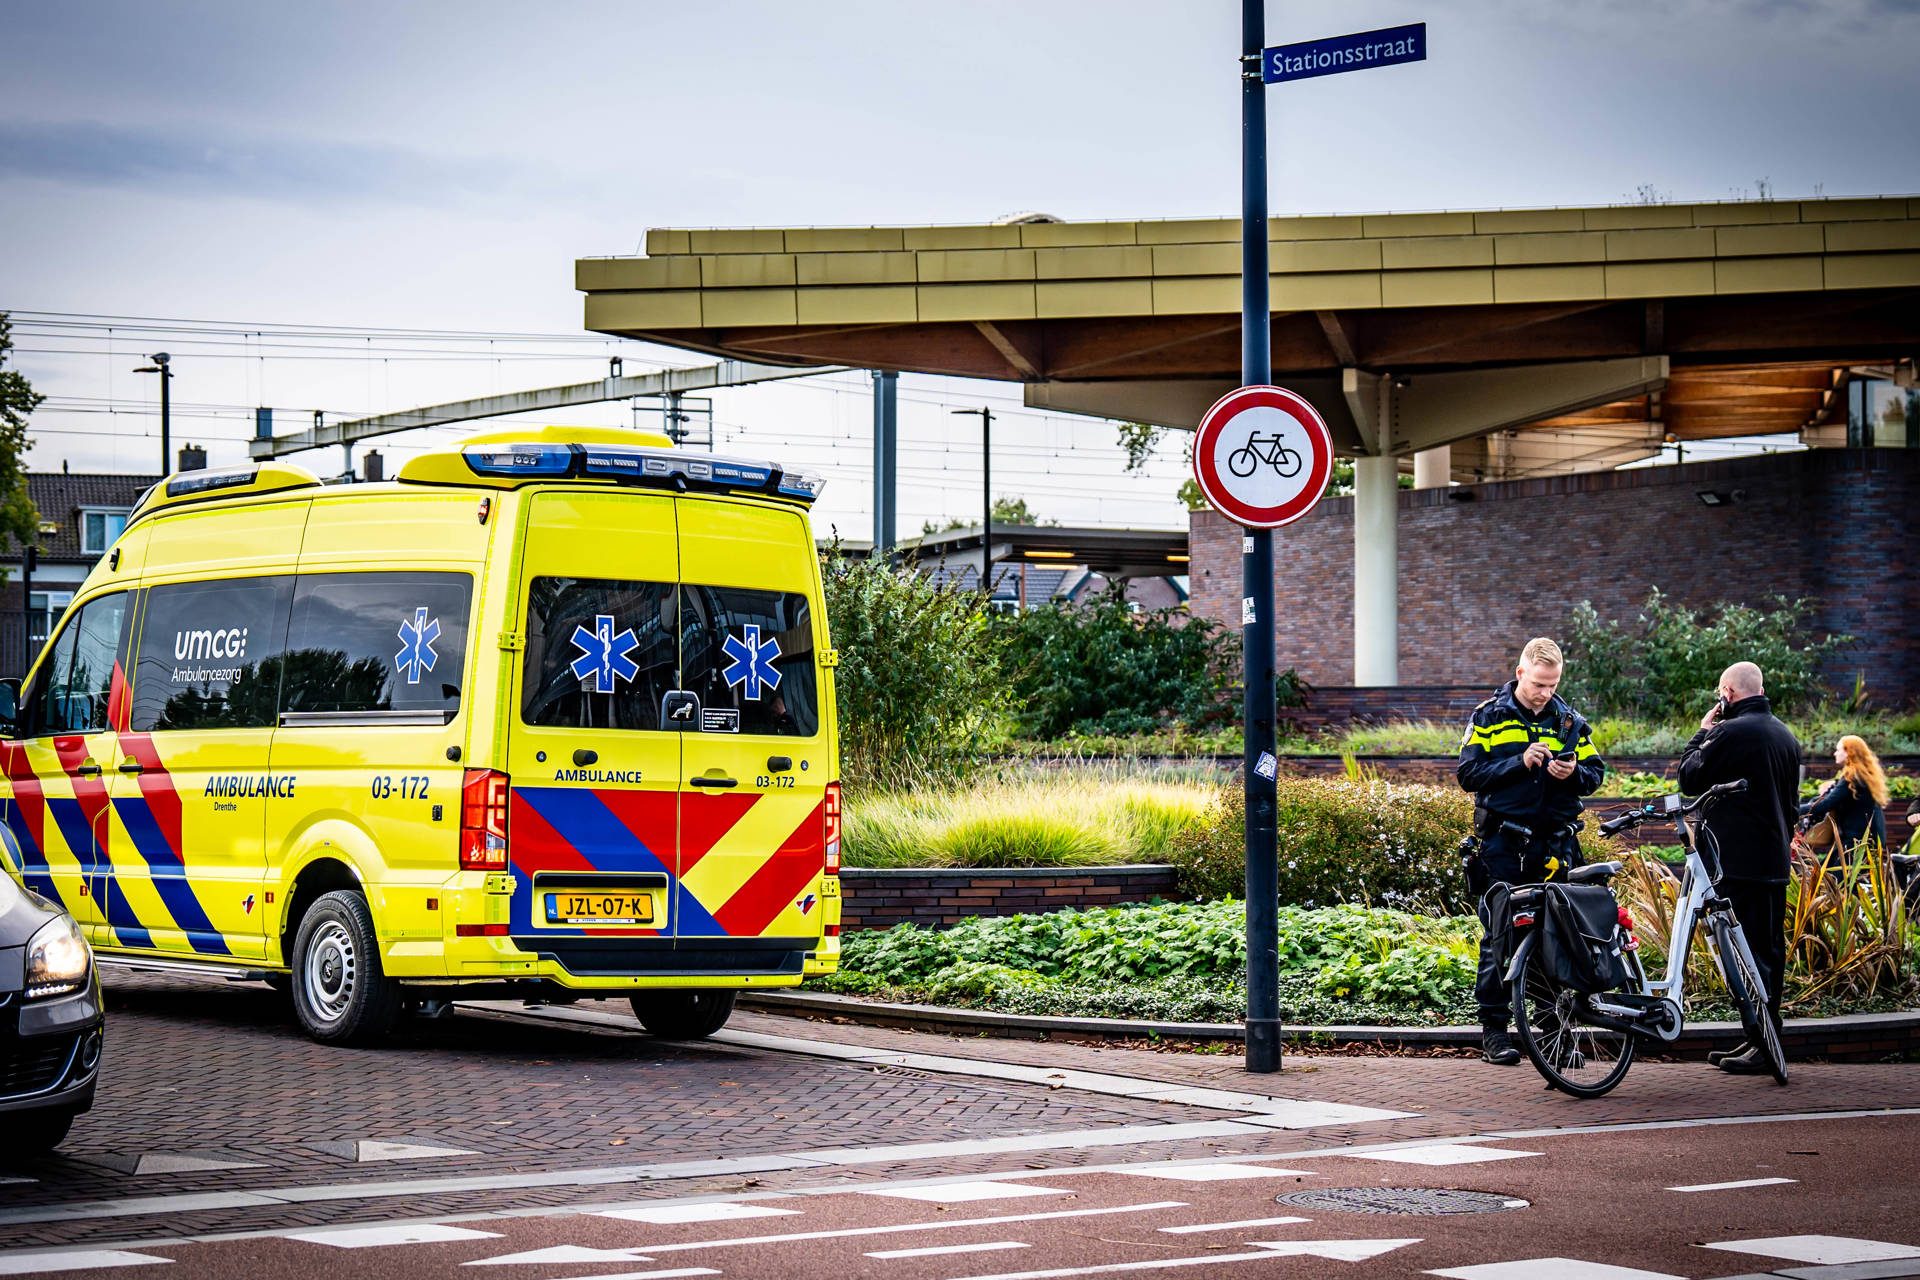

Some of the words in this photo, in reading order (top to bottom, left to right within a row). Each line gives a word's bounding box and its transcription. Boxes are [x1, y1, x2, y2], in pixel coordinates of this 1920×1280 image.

[1272, 36, 1415, 75] Stationsstraat
[171, 665, 242, 684] Ambulancezorg
[554, 769, 642, 783] AMBULANCE
[756, 776, 795, 788] 03-172
[204, 775, 297, 798] AMBULANCE
[371, 775, 430, 799] 03-172
[214, 801, 237, 811] Drenthe
[566, 898, 643, 915] JZL-07-K
